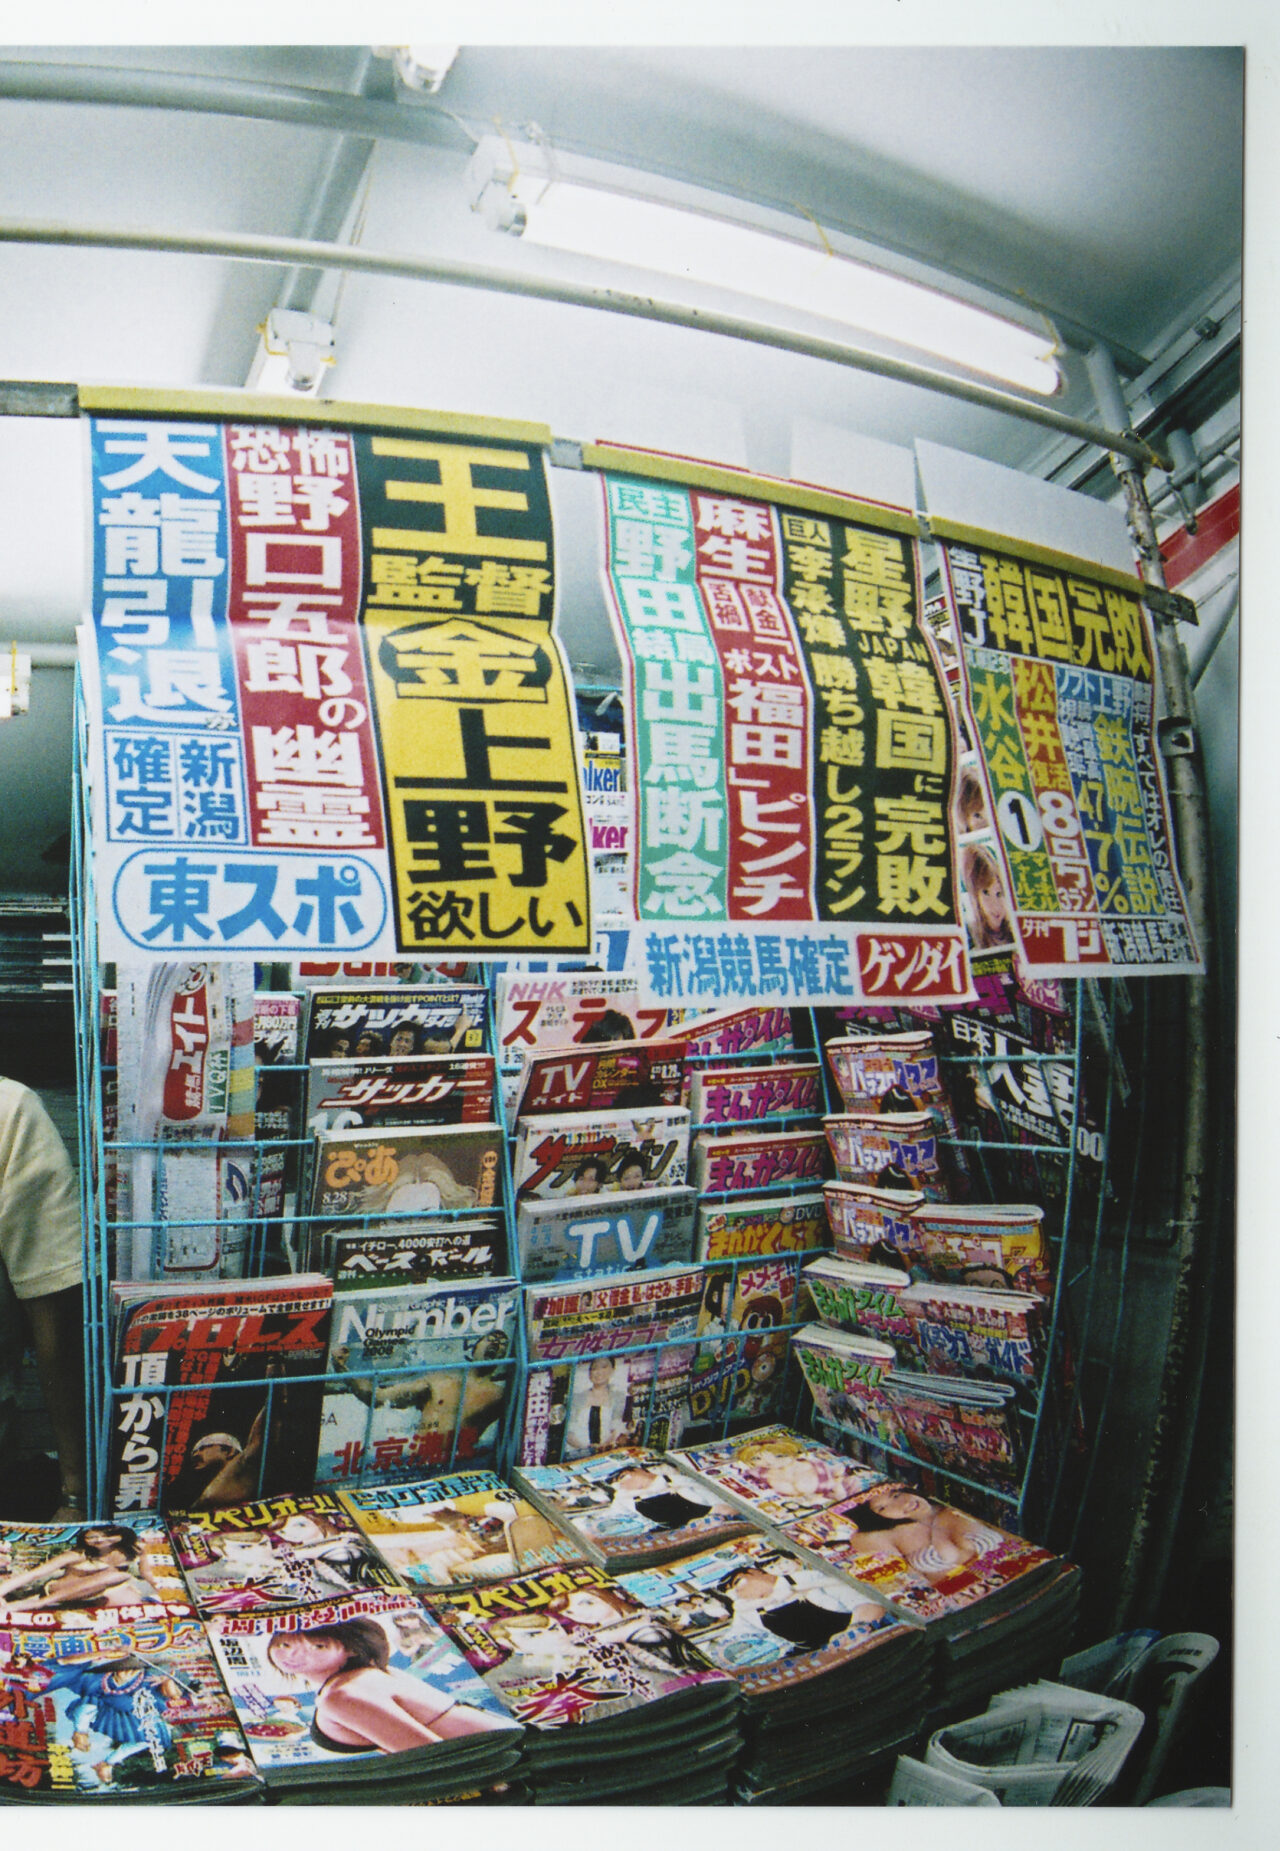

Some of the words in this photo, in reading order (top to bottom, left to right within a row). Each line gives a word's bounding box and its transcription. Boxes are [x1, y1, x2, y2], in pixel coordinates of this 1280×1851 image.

[617, 486, 685, 521] 民主
[789, 517, 826, 543] 巨人
[696, 495, 774, 584] 麻生
[614, 518, 705, 634] 野田
[841, 527, 914, 640] 星野
[237, 474, 376, 847] 野口五郎の幽霊
[858, 633, 929, 662] JAPAN
[973, 674, 1027, 792] 水谷
[113, 738, 174, 842] 確定
[179, 738, 236, 842] 新潟
[636, 657, 723, 916] 出馬断念
[727, 677, 807, 915] 福田」ピンチ
[811, 651, 870, 914] 勝ち越し2ラン
[862, 656, 952, 916] 韓国に完敗
[589, 824, 628, 849] ker
[142, 859, 363, 944] 東スポ
[406, 892, 584, 941] 欲しい
[507, 981, 567, 1001] NHK
[645, 932, 855, 997] 新潟競馬確定
[861, 937, 964, 994] ゲンダイ
[320, 1075, 488, 1108] サッカー
[538, 1060, 591, 1095] TV
[325, 1149, 400, 1189] ぴあ
[568, 1213, 660, 1269] TV
[140, 1310, 328, 1350] プロレス
[338, 1297, 514, 1344] Number
[187, 1491, 342, 1533] スペリオール
[447, 1565, 619, 1619] スペリオール
